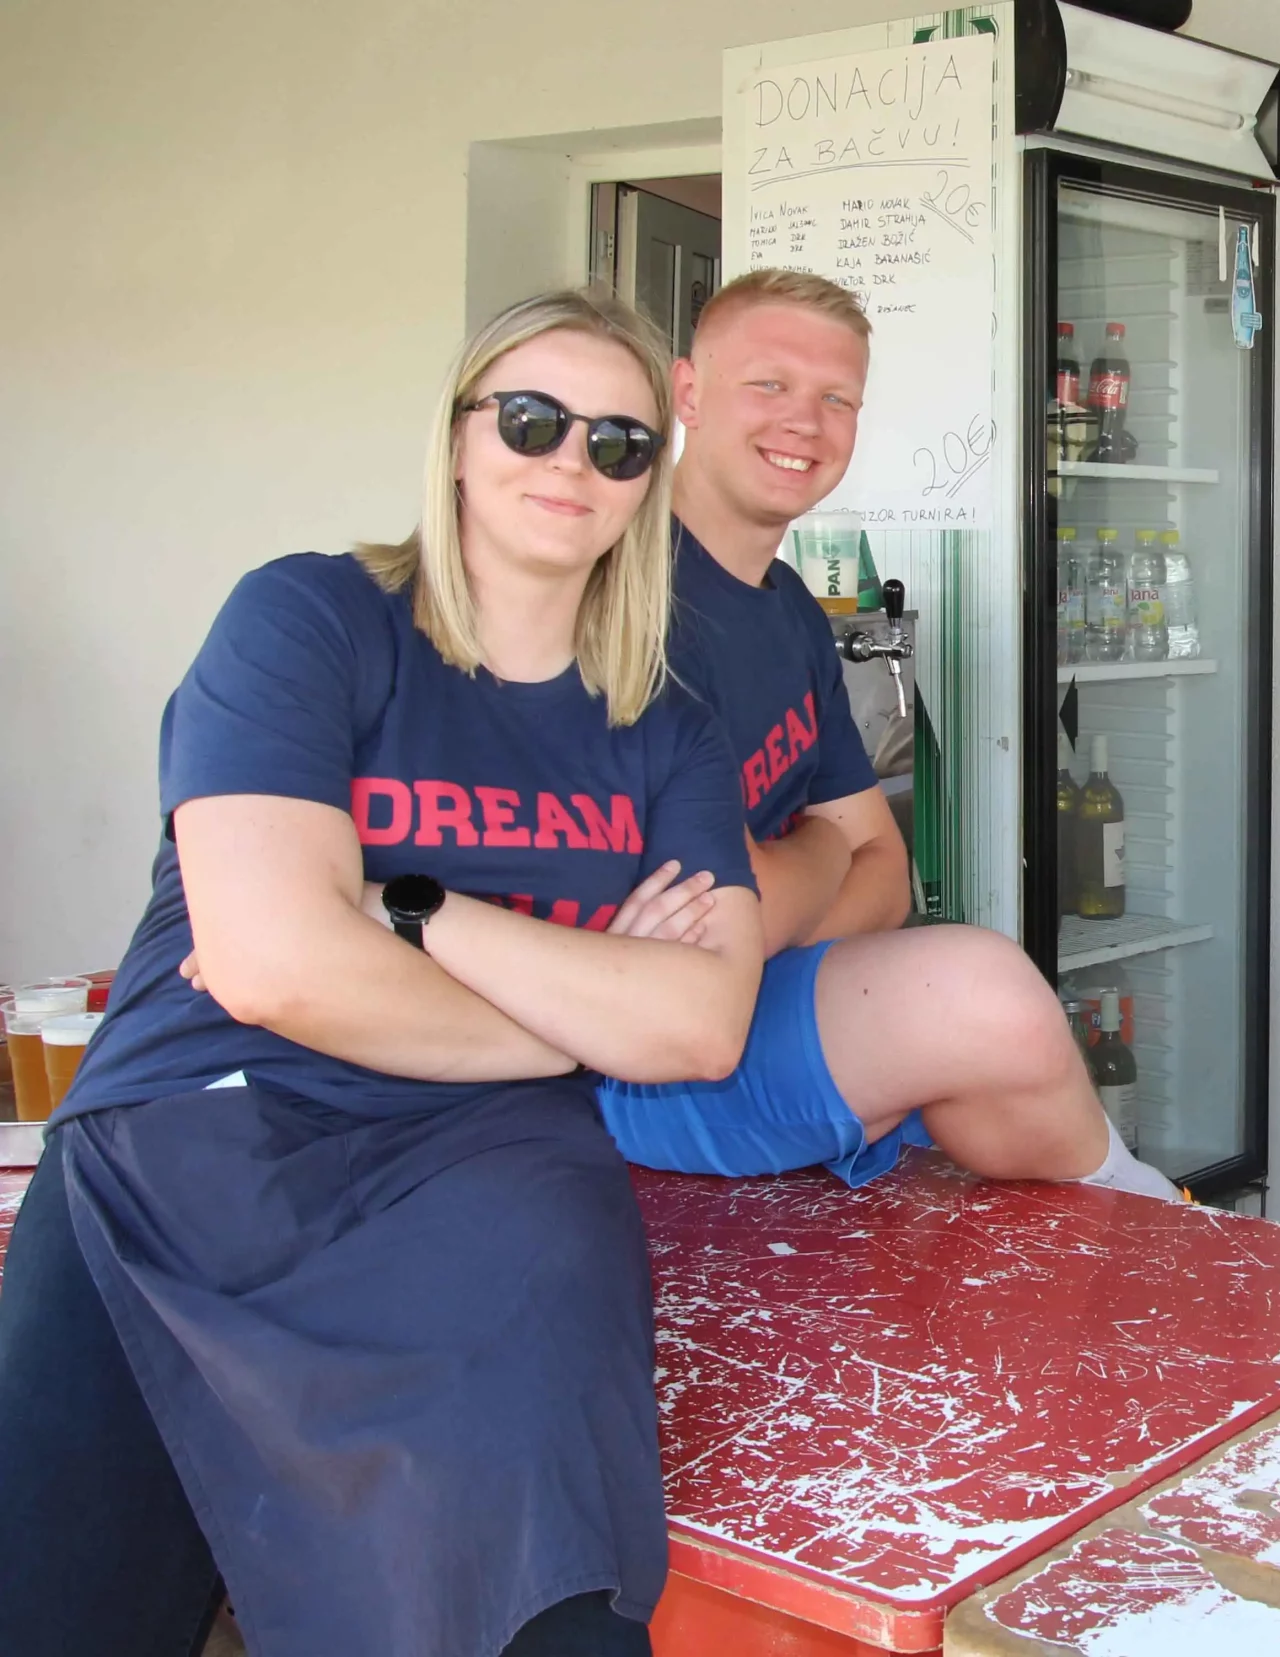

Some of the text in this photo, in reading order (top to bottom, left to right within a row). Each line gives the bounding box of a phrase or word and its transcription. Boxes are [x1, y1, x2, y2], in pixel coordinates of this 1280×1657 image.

[748, 146, 794, 174] ZA
[842, 197, 910, 212] MARIO NOVAK
[840, 217, 871, 230] DAMIR
[880, 228, 916, 246] BOŽIĆ
[836, 248, 931, 269] KAJA BARANAŠIĆ
[872, 273, 896, 285] DRK
[828, 559, 841, 597] PAN
[350, 777, 643, 854] DREAM
